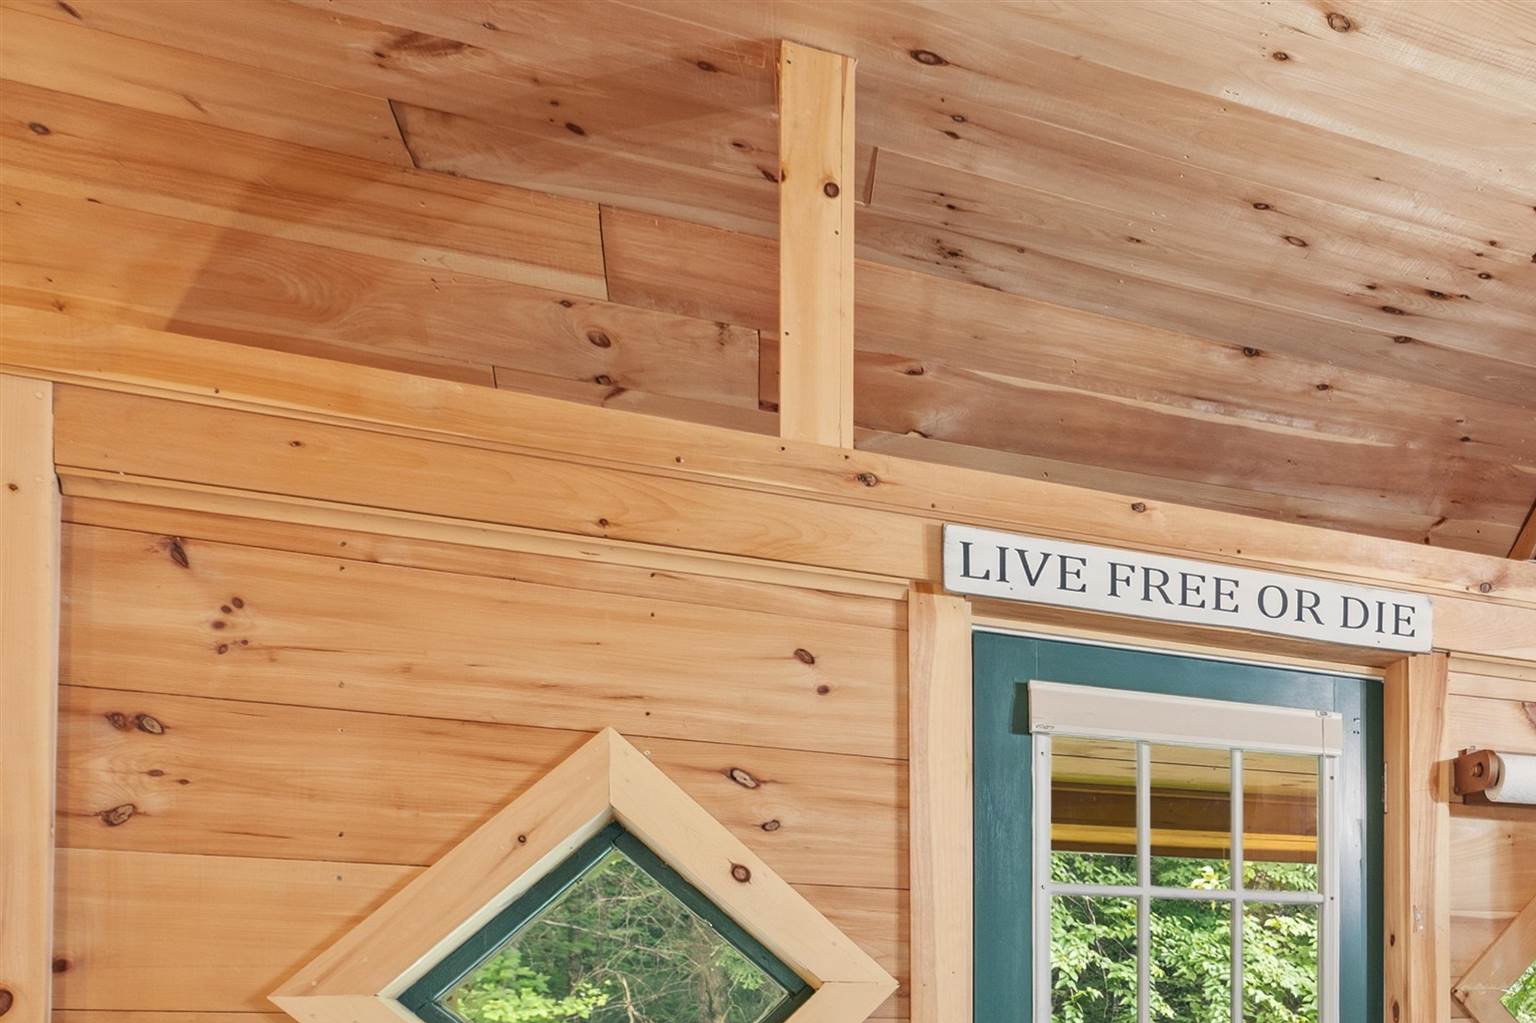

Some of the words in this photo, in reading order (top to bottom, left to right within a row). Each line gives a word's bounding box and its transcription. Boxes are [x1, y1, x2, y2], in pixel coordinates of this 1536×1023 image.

[958, 541, 1088, 593] LIVE
[1107, 560, 1240, 614] FREE
[1257, 584, 1325, 625] OR
[1340, 595, 1417, 638] DIE
